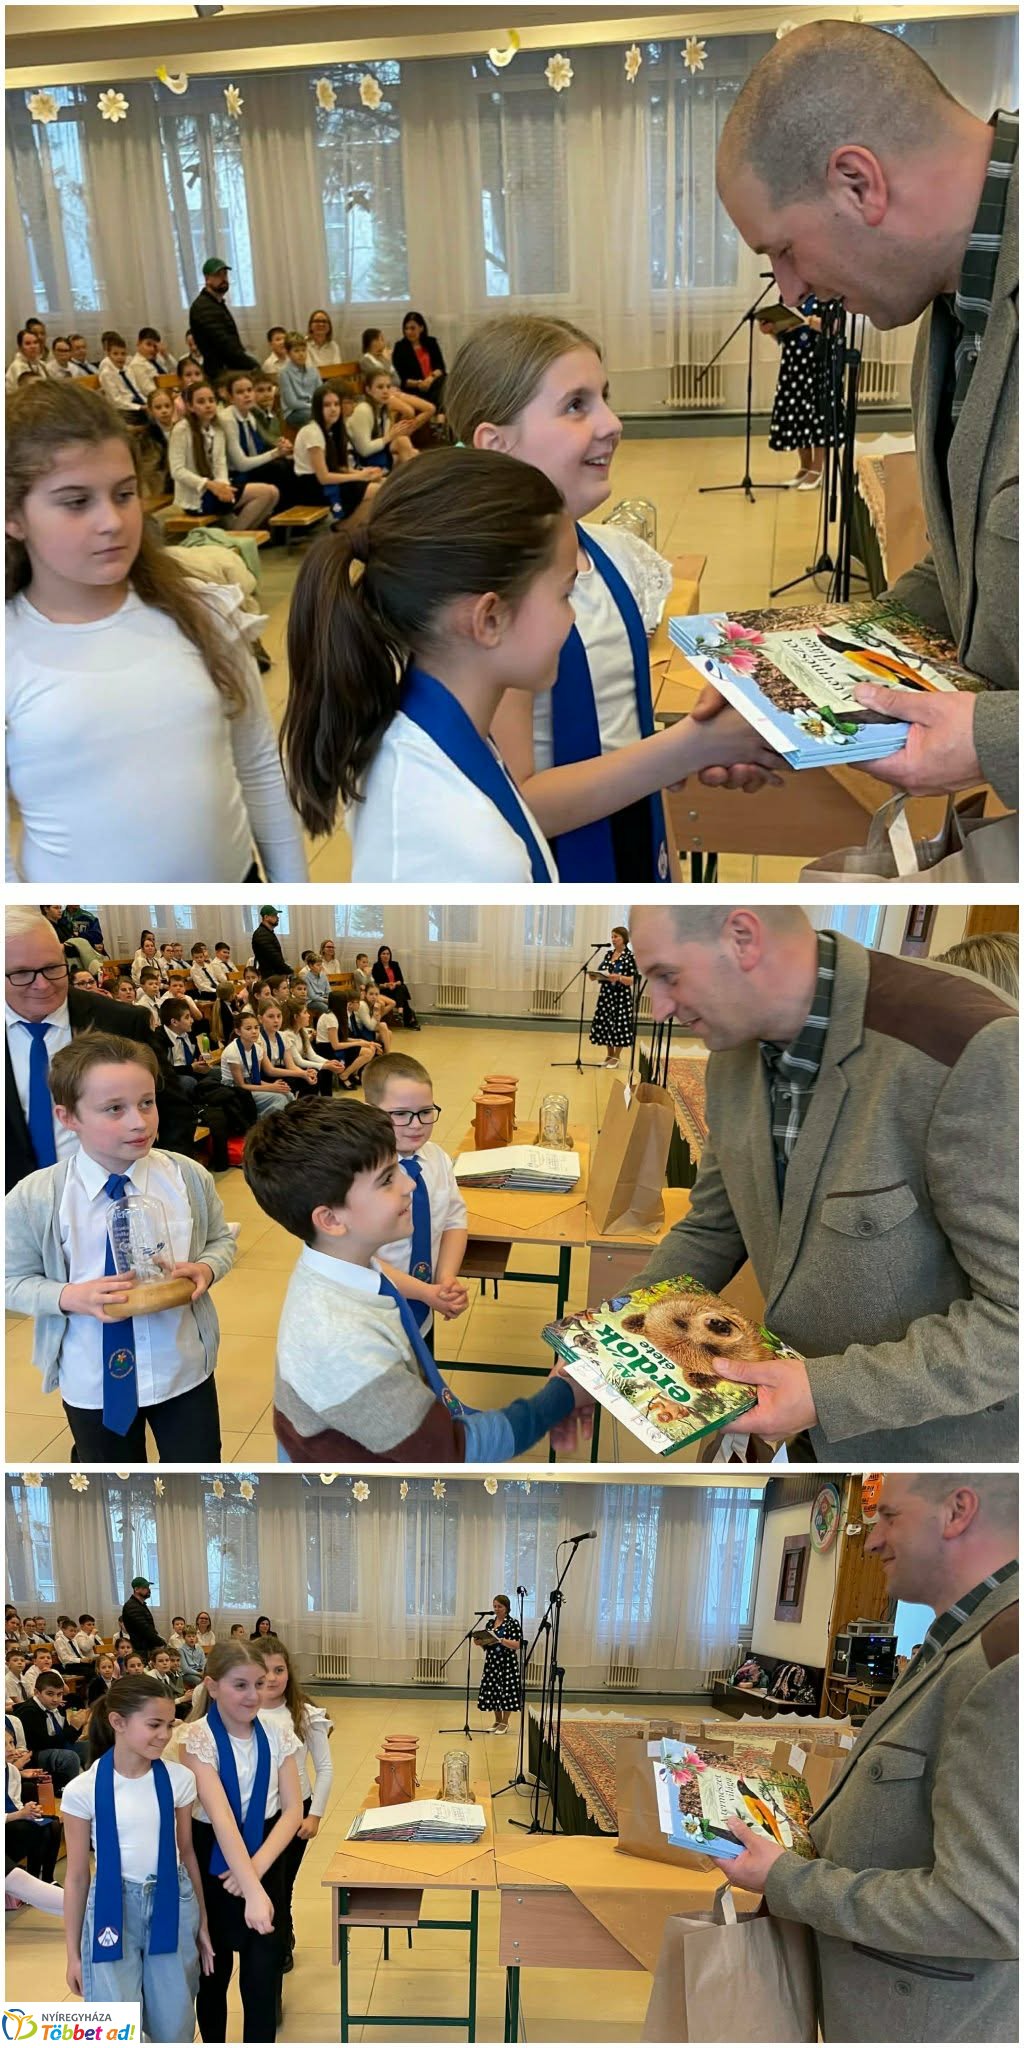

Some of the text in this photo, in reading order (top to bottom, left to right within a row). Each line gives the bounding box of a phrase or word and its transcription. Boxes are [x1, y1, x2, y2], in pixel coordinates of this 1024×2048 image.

[782, 639, 845, 691] természet
[800, 636, 836, 668] világa
[595, 1323, 692, 1404] erdők
[613, 1362, 636, 1379] Az
[639, 1340, 676, 1370] élete
